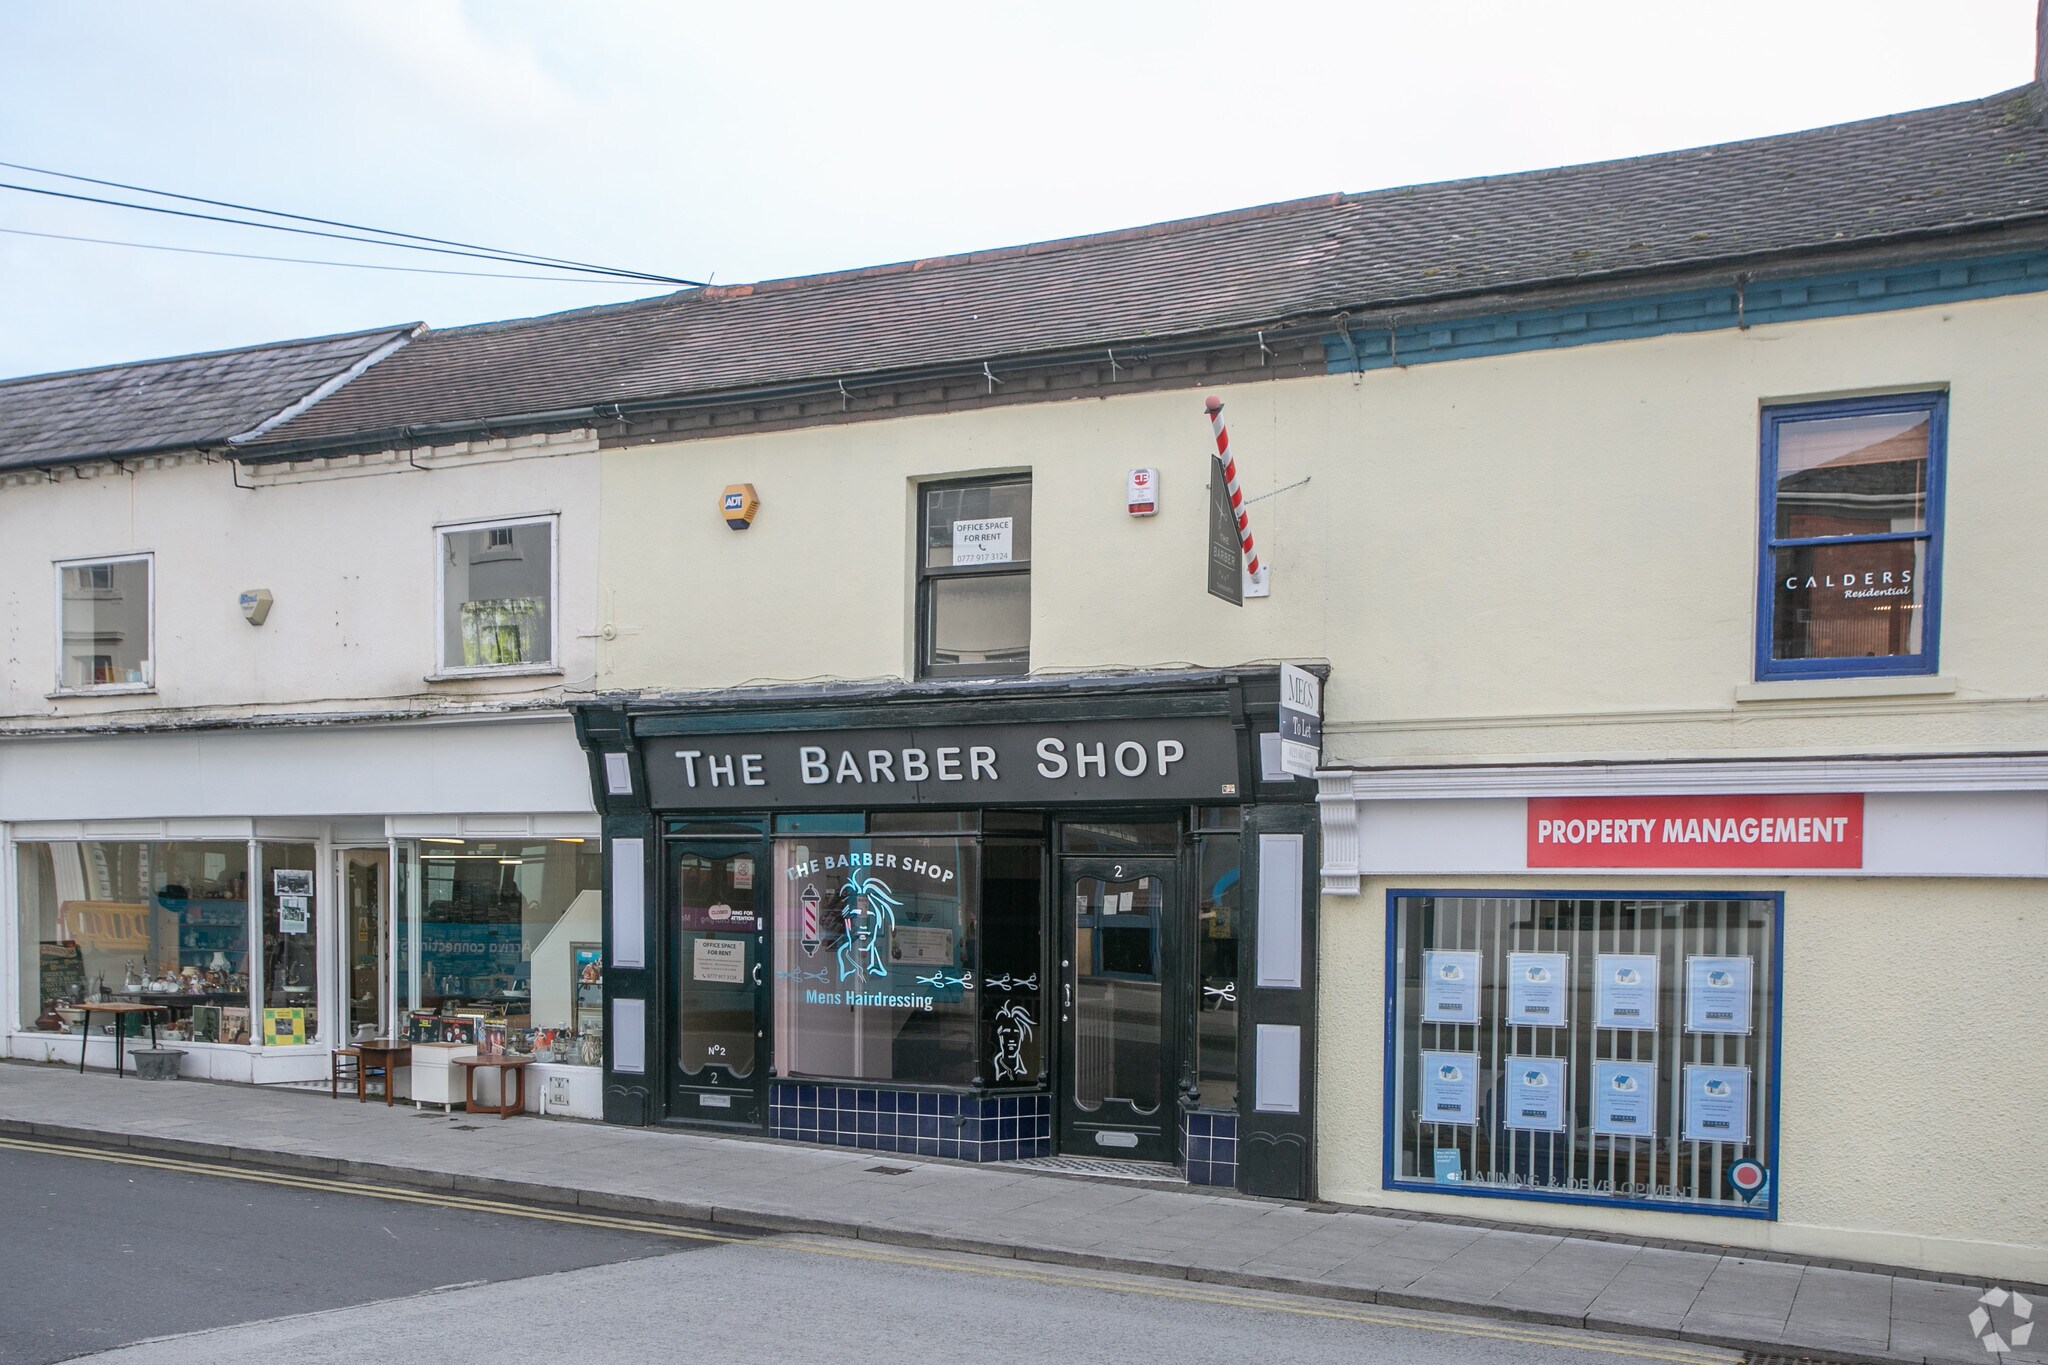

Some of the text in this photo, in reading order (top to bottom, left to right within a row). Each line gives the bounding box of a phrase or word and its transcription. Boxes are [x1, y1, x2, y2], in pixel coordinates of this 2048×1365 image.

[725, 496, 743, 508] ADT
[956, 521, 1009, 532] OFFICE SPACE
[964, 532, 1002, 542] FOR RENT
[1220, 532, 1230, 546] THE
[957, 552, 1008, 562] 0777 917 3124
[1213, 546, 1236, 568] BARBER
[1785, 570, 1912, 590] CALDERS
[1844, 586, 1911, 599] Residential
[1288, 674, 1314, 710] MECS
[1292, 716, 1311, 738] To Let
[675, 737, 1185, 788] THE BARBER SHOP
[1538, 817, 1848, 844] PROPERTY MANAGEMENT
[786, 852, 954, 883] THE BARBER SHOP
[1114, 865, 1123, 878] 2
[806, 990, 934, 1012] Mens Hairdressing
[710, 1072, 718, 1084] 2
[1457, 1169, 1698, 1202] PLANNING & DEVELOPMENT
